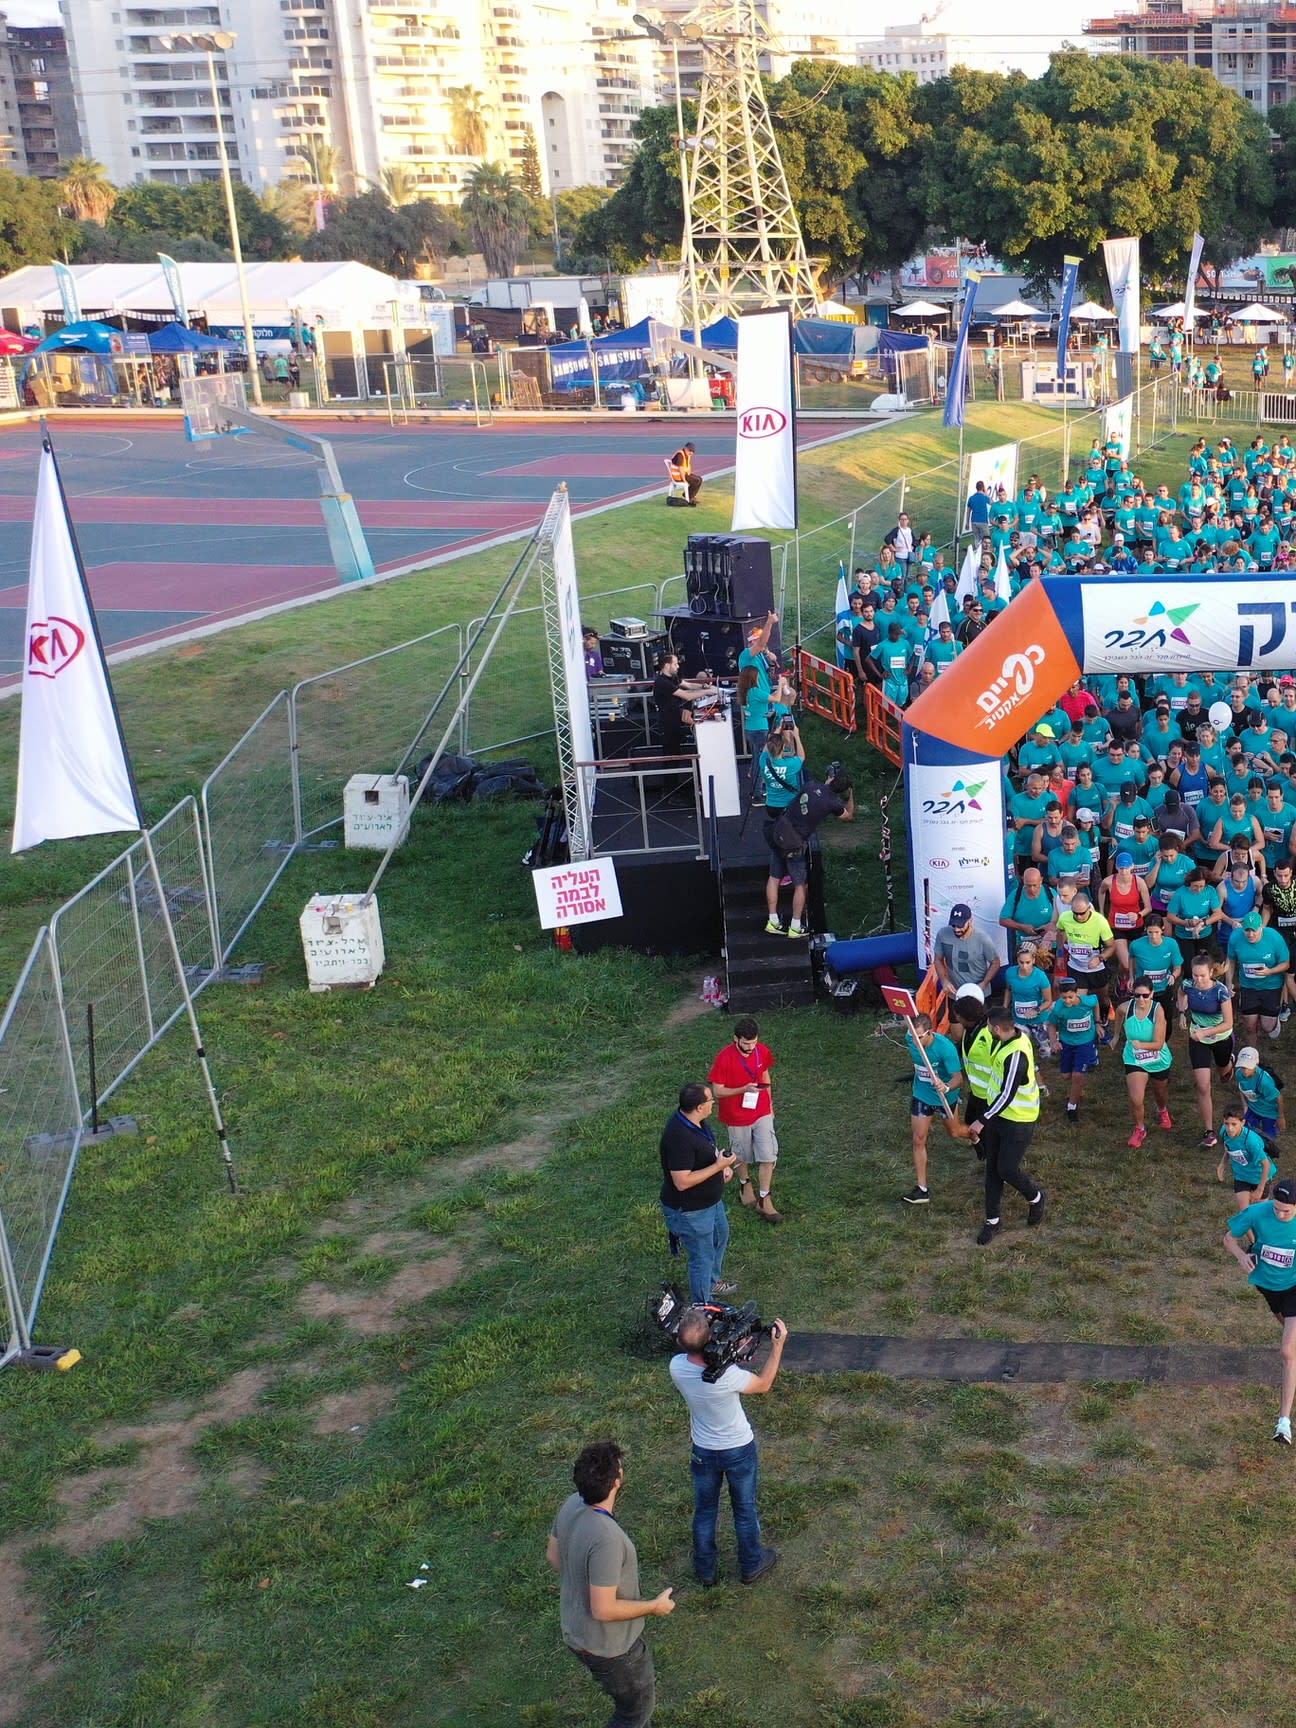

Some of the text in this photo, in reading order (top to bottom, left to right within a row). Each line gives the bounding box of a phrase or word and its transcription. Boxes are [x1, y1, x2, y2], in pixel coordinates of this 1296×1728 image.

[553, 357, 589, 377] SAMSUNG
[597, 348, 642, 367] SAMSUNG
[742, 412, 778, 434] KIA
[551, 869, 600, 889] העליה
[557, 883, 599, 904] לבמה
[556, 898, 606, 918] אסורה
